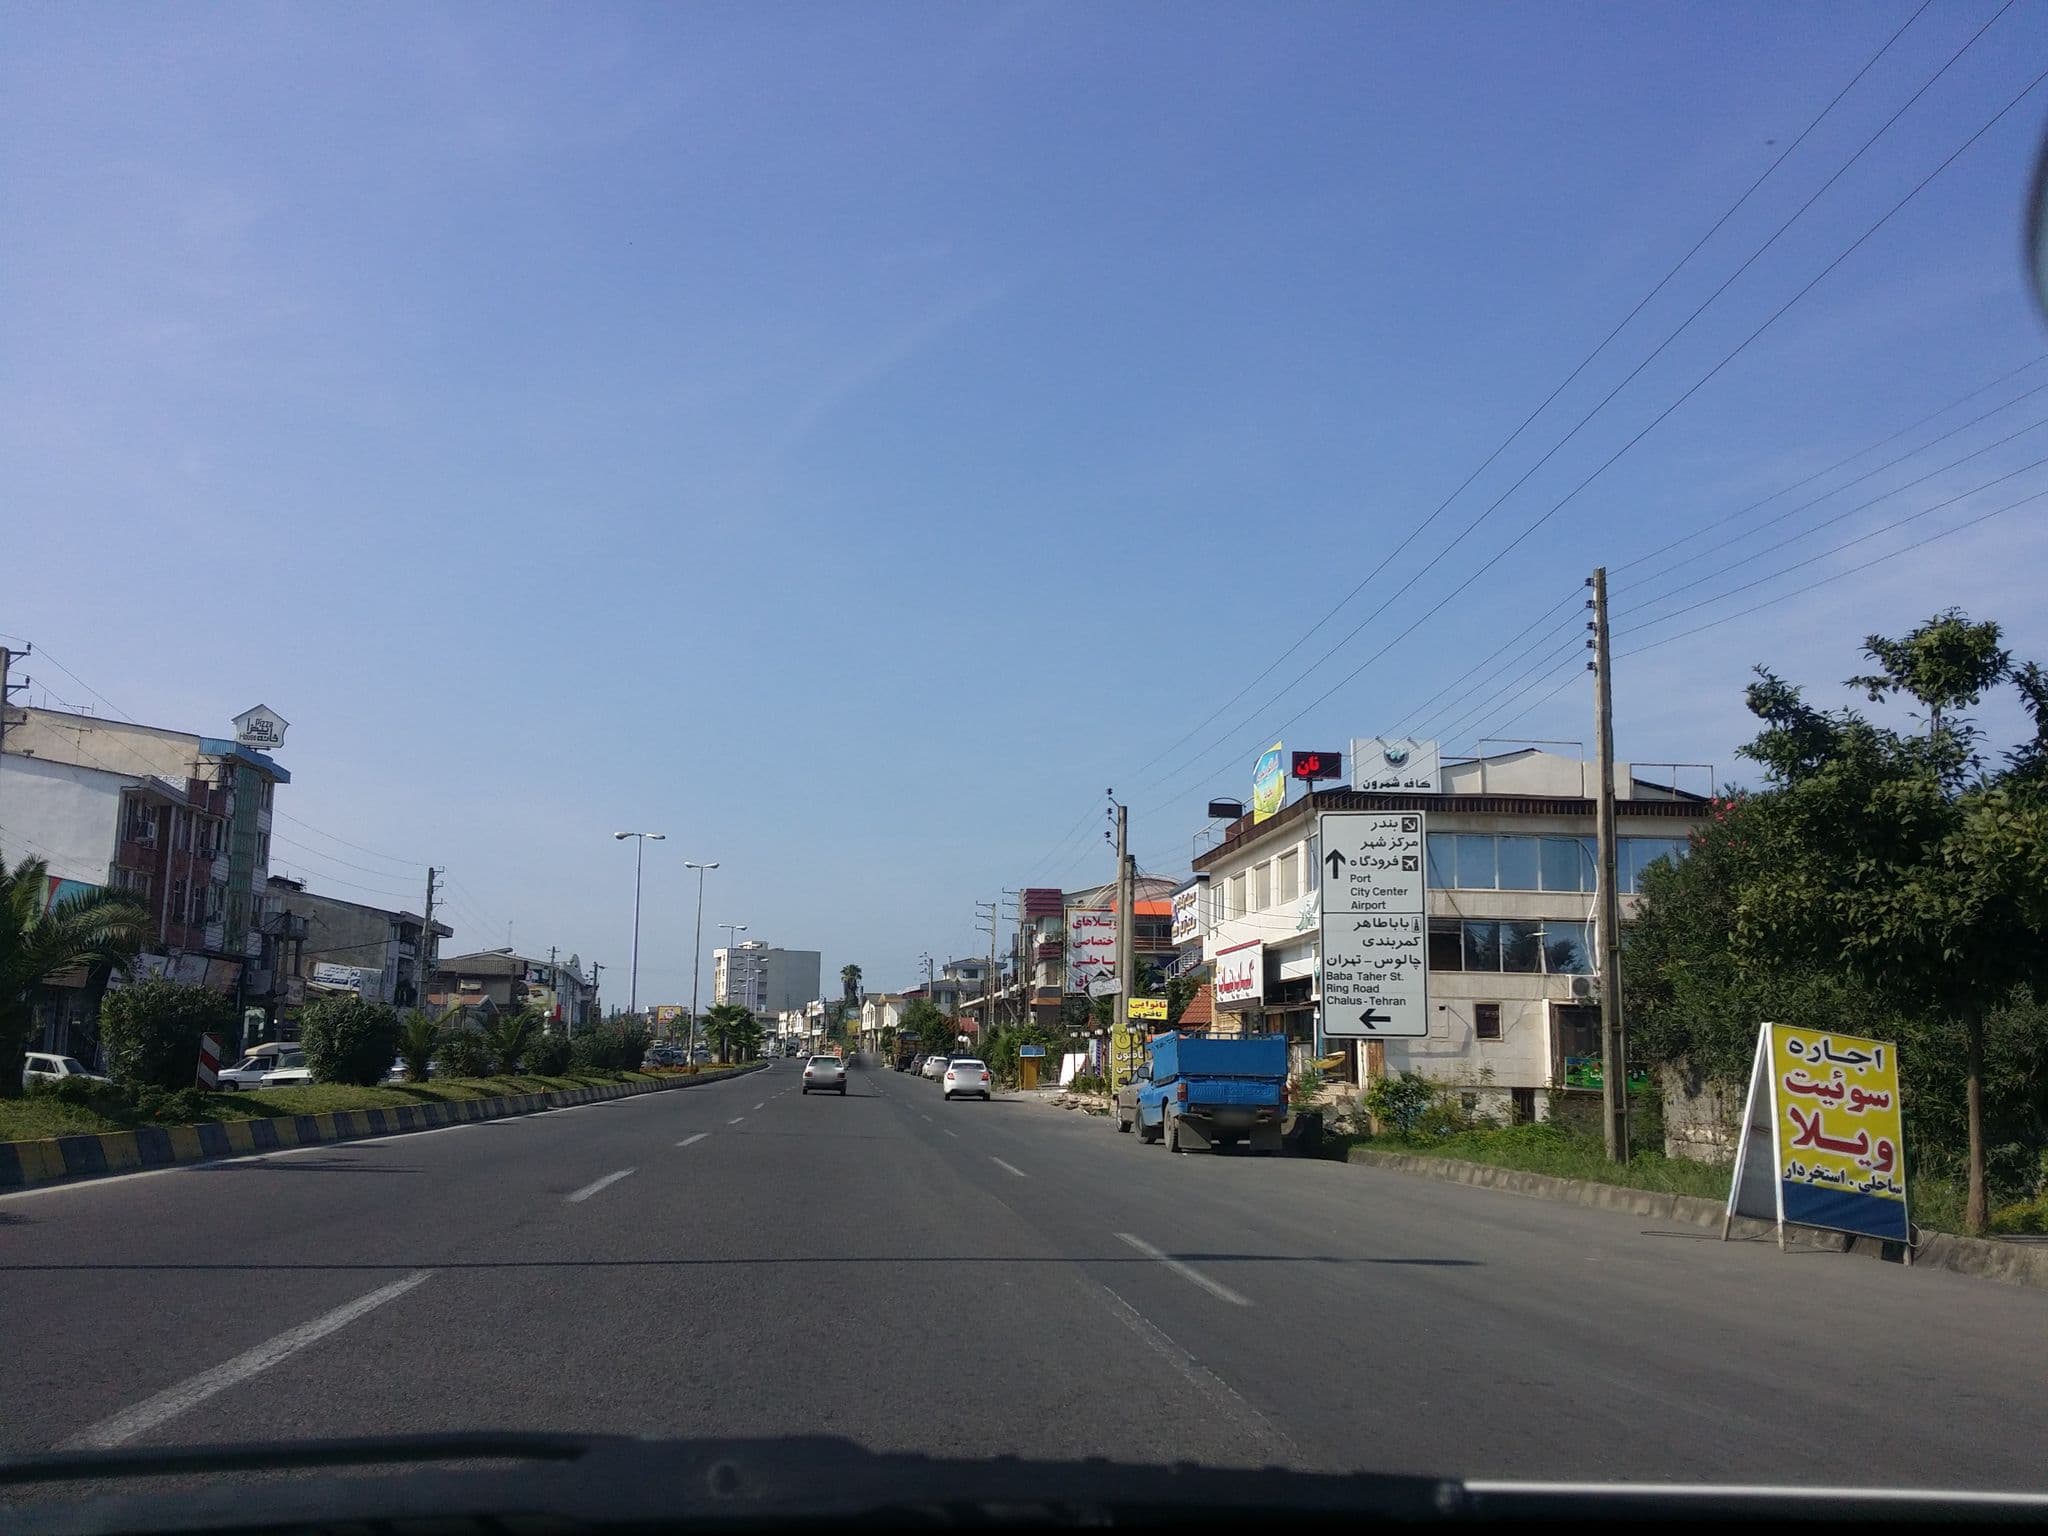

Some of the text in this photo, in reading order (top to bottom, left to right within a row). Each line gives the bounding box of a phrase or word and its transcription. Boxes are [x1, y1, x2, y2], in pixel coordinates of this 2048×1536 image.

[256, 718, 273, 727] Pizza
[1363, 776, 1431, 790] کافه شمرون
[1370, 819, 1398, 832] بندر
[1360, 836, 1418, 851] مرکز شهر
[1350, 855, 1399, 870] فرودگاه
[1350, 874, 1371, 883] Port
[1350, 887, 1408, 898] City Center
[1351, 901, 1386, 911] Airport
[1362, 936, 1421, 950] کمربندی
[1327, 954, 1362, 968] تهران
[1374, 954, 1422, 970] چالوس
[1326, 971, 1404, 981] Baba Taher St.
[1326, 984, 1380, 994] Ring Road
[1788, 1039, 1882, 1073] اجاره
[1785, 1070, 1890, 1113] سوئیت
[1789, 1107, 1895, 1173] ویلا
[1858, 1175, 1903, 1194] ساحلی
